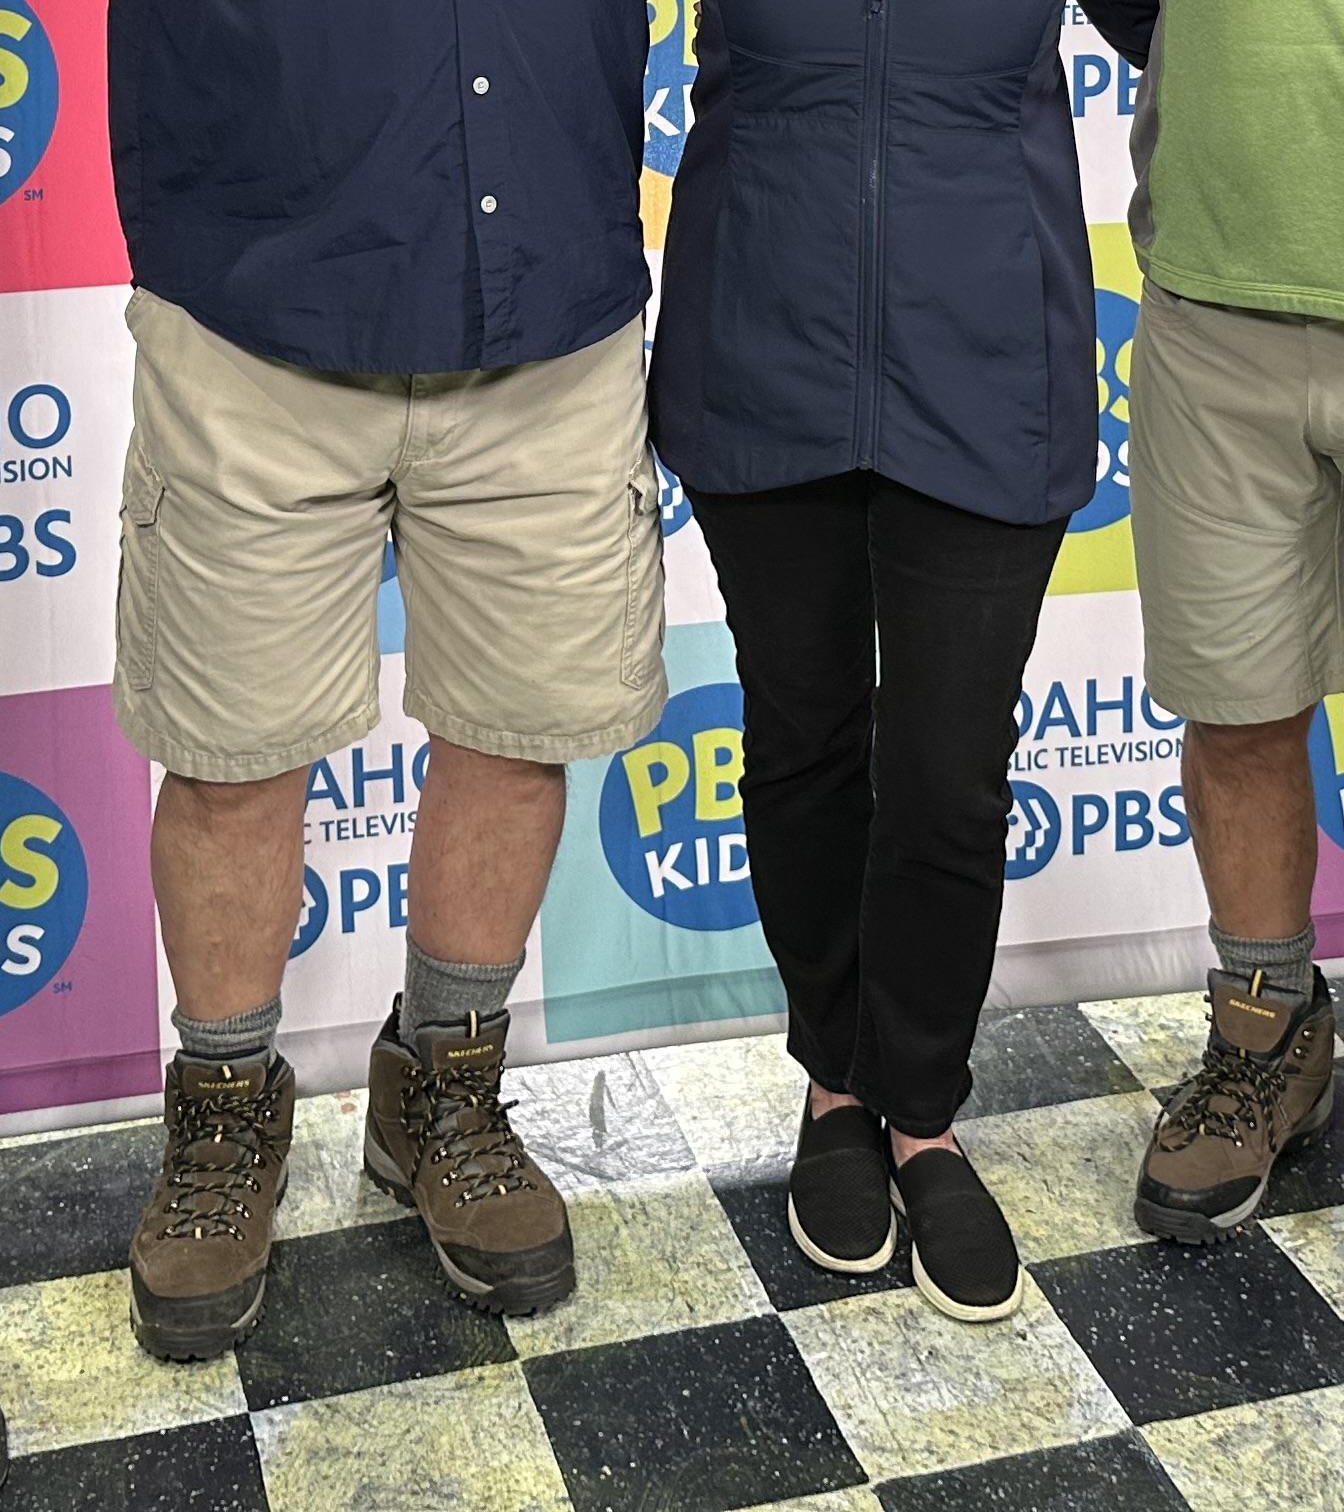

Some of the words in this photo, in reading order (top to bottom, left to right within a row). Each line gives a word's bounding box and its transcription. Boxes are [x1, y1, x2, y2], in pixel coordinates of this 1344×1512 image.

[1073, 54, 1140, 118] PB
[24, 189, 43, 201] SM
[621, 728, 745, 838] PB
[320, 811, 418, 842] TELEVIS
[1072, 785, 1192, 855] PBS
[645, 833, 751, 898] KID
[340, 863, 409, 934] PB
